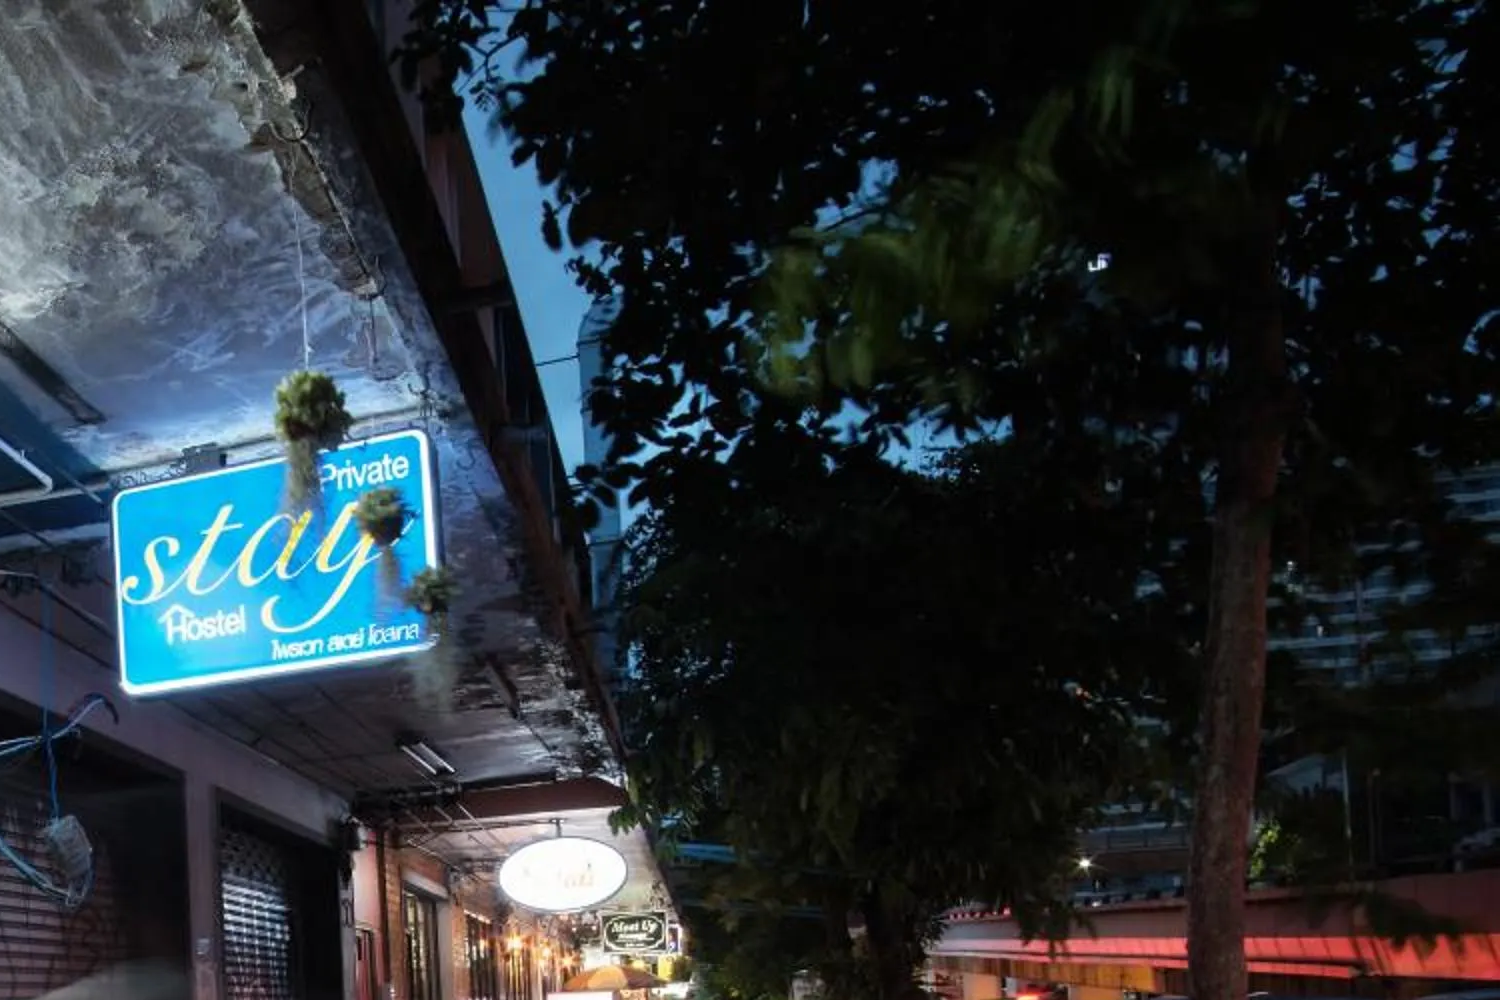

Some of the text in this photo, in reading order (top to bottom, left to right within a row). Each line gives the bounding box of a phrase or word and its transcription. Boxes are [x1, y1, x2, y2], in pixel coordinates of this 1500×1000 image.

[319, 454, 409, 491] Private
[121, 502, 418, 634] stay
[160, 604, 246, 645] Hostel
